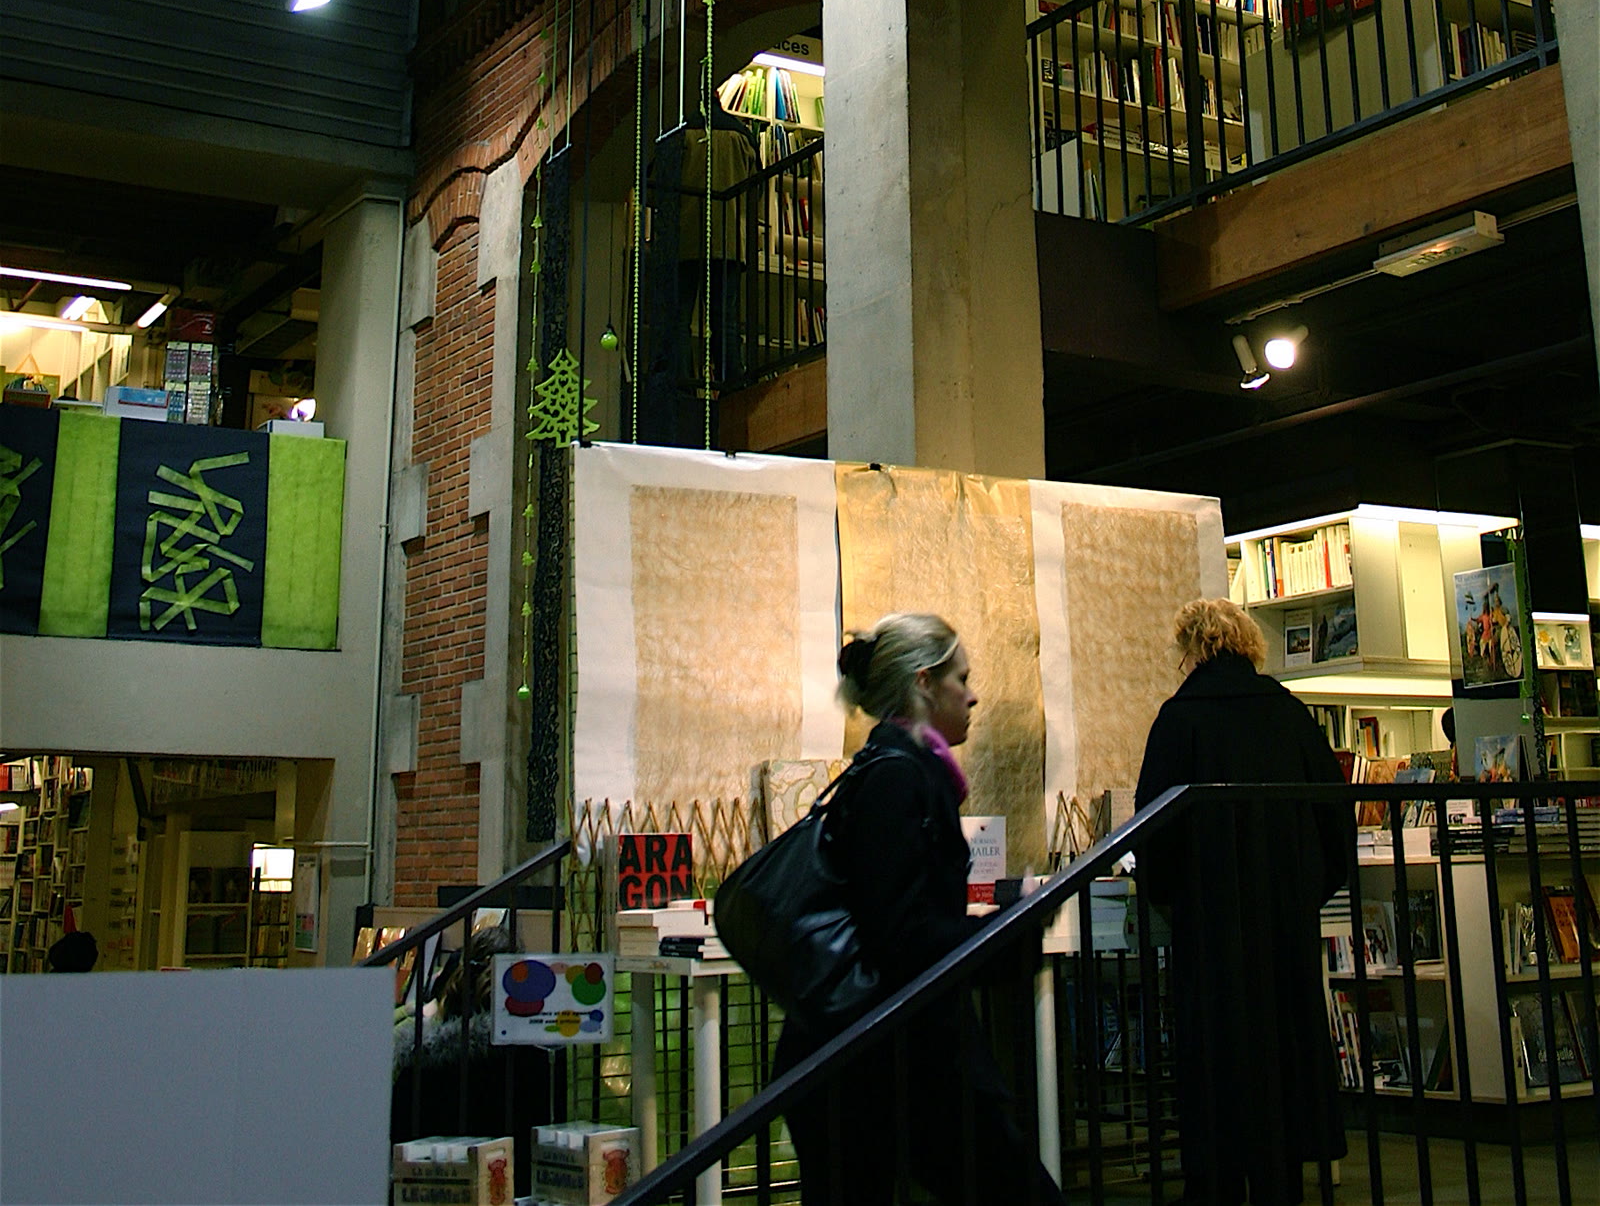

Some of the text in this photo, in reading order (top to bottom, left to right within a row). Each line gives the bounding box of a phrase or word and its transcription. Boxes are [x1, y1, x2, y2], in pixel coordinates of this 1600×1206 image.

[619, 834, 692, 873] ARA
[970, 846, 1001, 857] MAILER
[619, 874, 692, 910] GON
